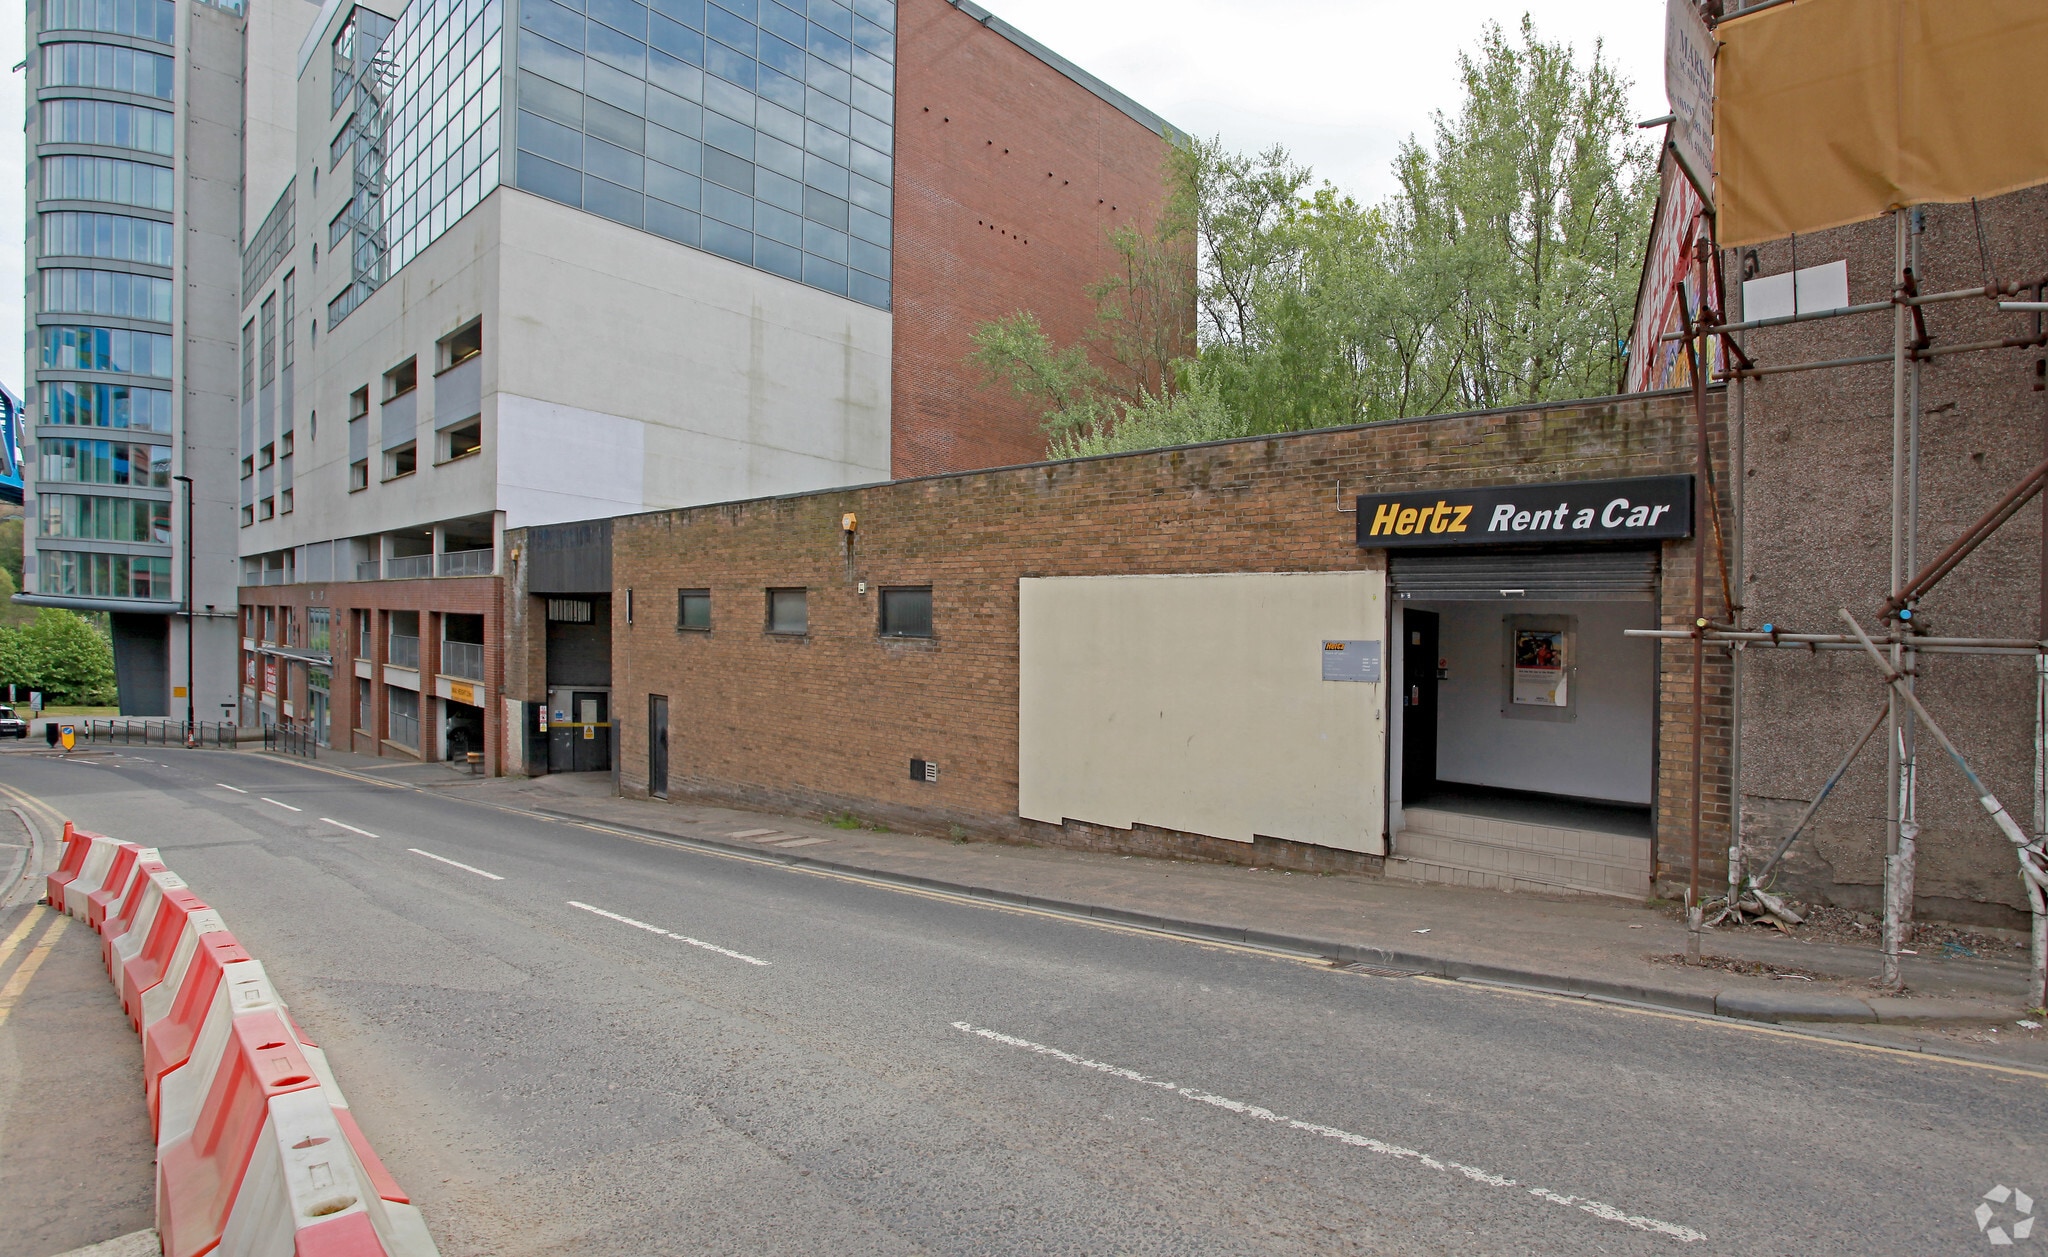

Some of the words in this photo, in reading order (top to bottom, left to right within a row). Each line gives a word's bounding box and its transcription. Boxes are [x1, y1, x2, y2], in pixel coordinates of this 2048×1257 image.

[1369, 500, 1473, 536] Hertz
[1487, 502, 1569, 532] Rent
[1572, 508, 1595, 530] a
[1601, 498, 1671, 528] Car
